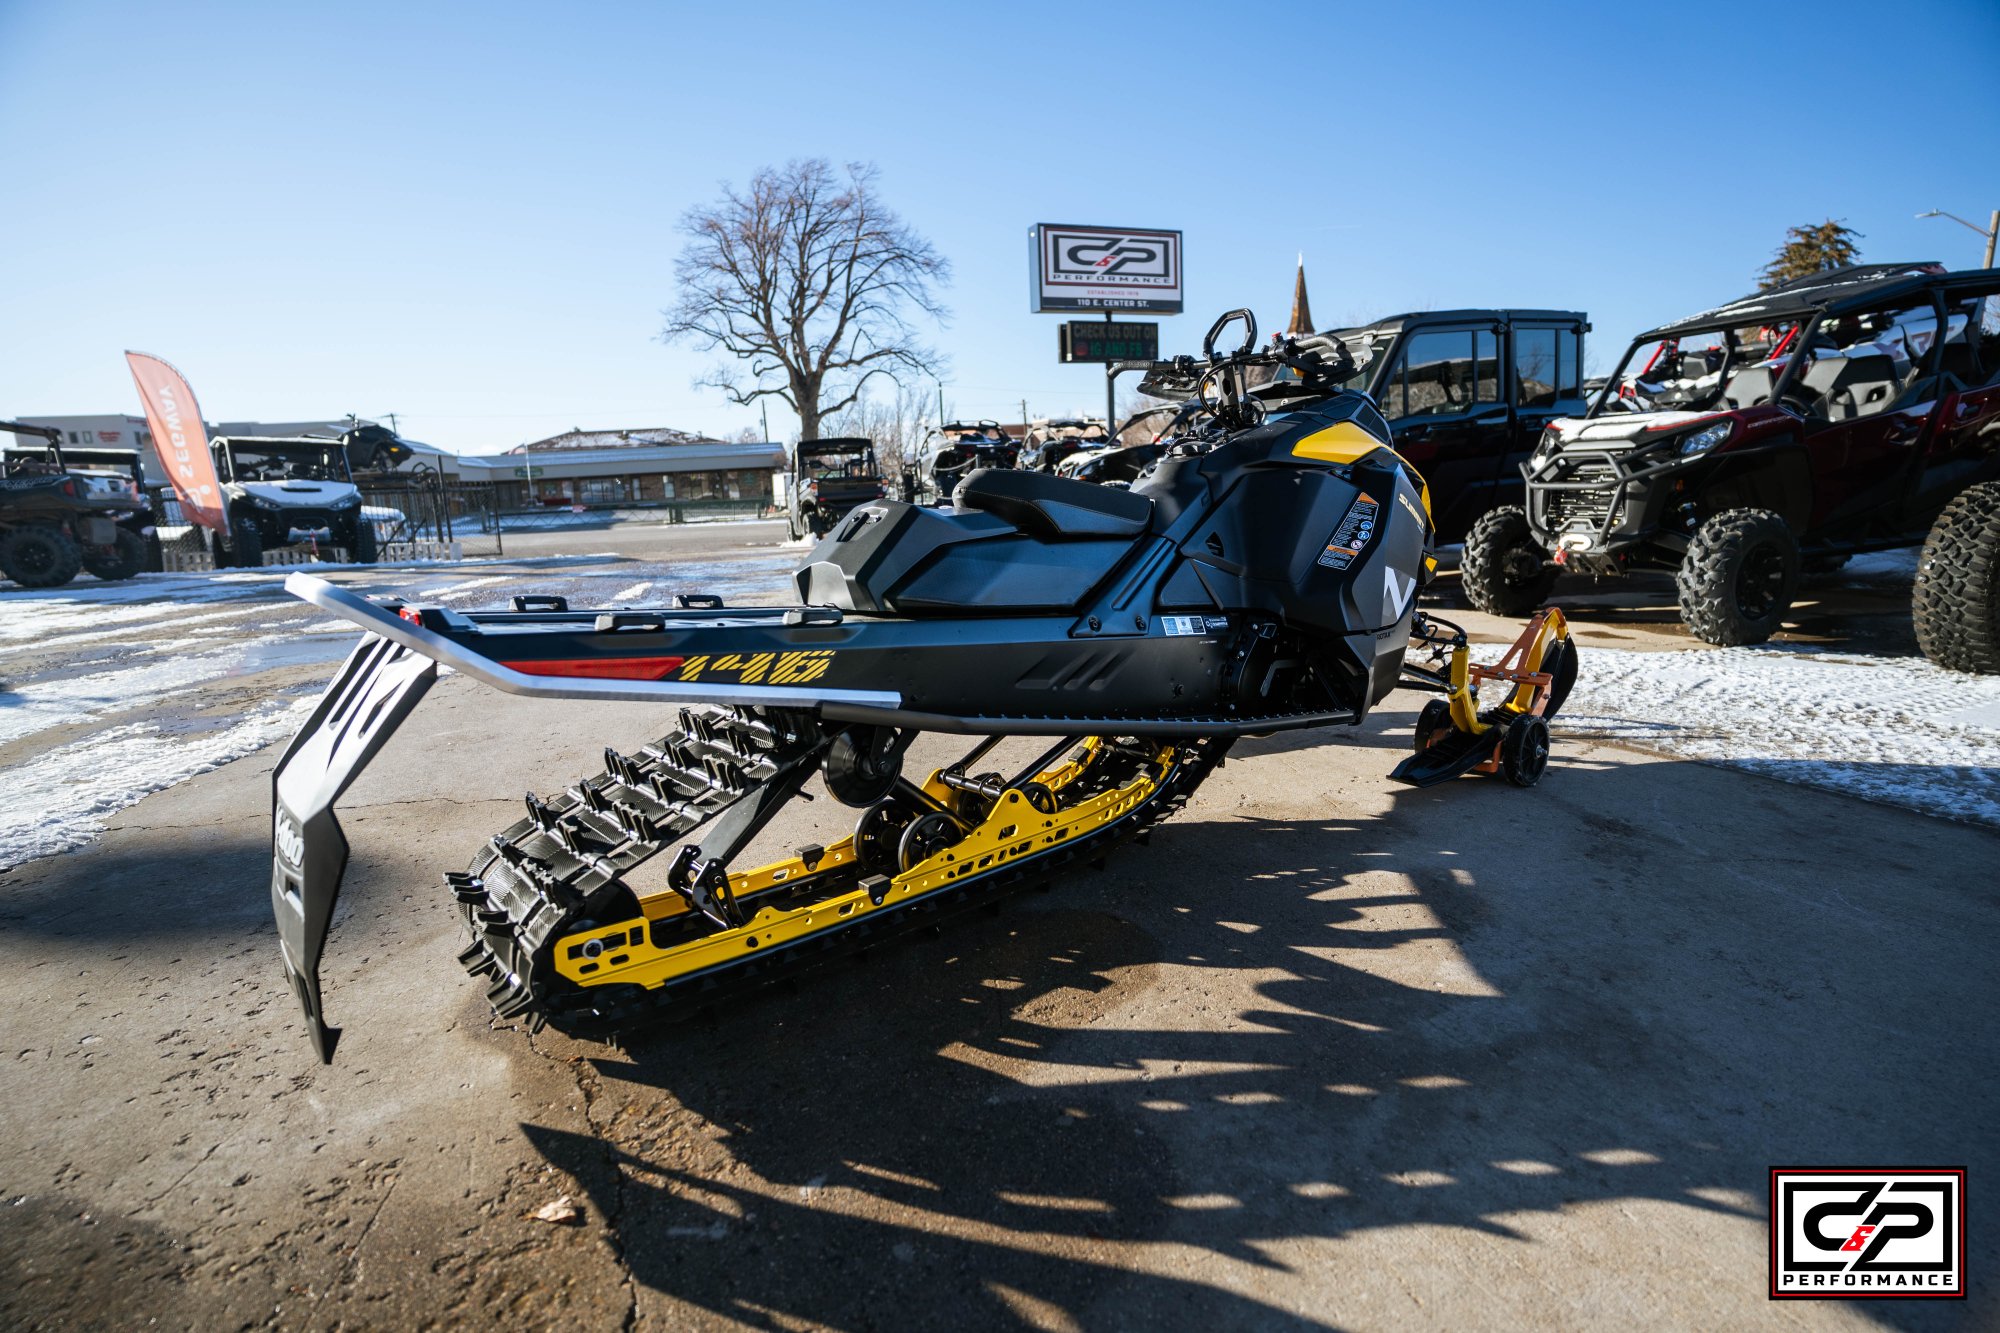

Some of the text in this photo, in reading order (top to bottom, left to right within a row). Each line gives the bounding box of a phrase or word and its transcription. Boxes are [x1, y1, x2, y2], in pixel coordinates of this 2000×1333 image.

[1053, 274, 1171, 284] PERFORMANCE
[1077, 298, 1090, 306] 110
[1103, 299, 1135, 307] CENTER
[1136, 300, 1149, 308] ST.
[1073, 324, 1106, 339] CHECK
[1109, 325, 1121, 339] US
[1123, 326, 1142, 340] OUT
[678, 650, 836, 685] 146
